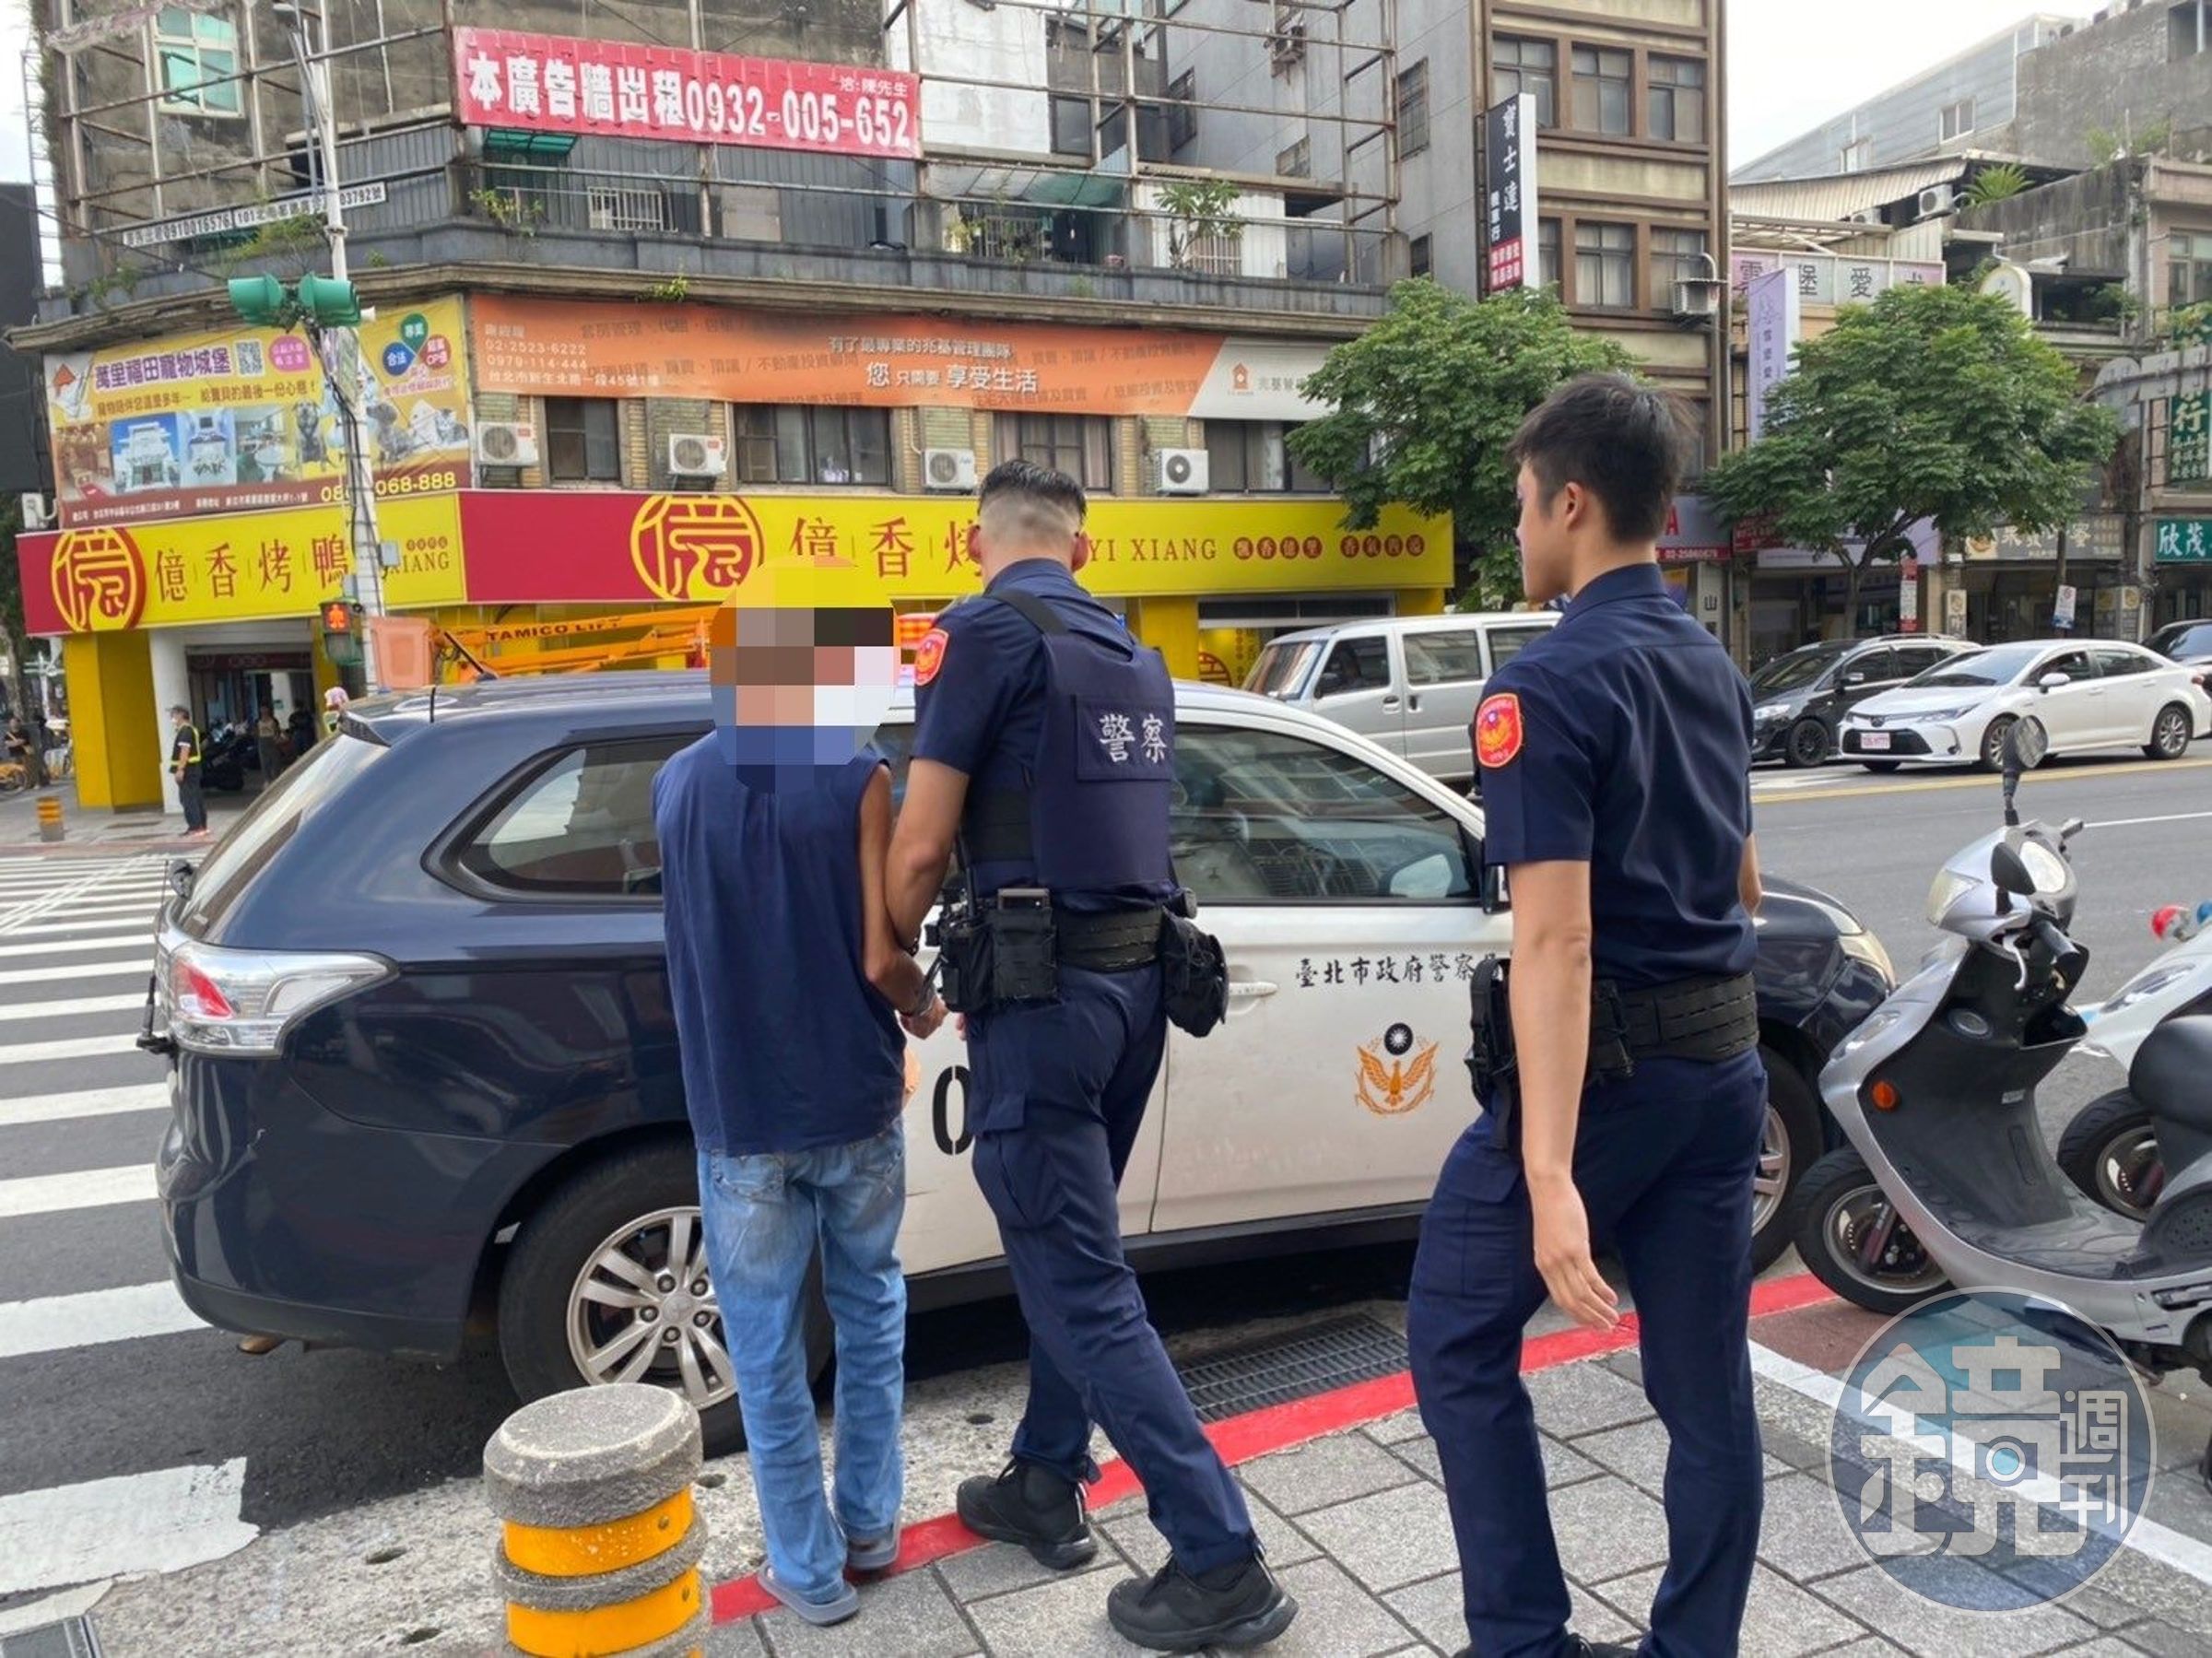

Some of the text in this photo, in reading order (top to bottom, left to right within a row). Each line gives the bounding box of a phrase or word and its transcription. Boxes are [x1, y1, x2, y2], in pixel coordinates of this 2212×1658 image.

[866, 362, 890, 387] 您
[947, 364, 1039, 394] 享受生活
[1132, 538, 1217, 562] XIANG
[155, 533, 348, 604] 億香烤鴨
[487, 617, 622, 641] TAMICO LIFT
[1100, 713, 1168, 764] 警察
